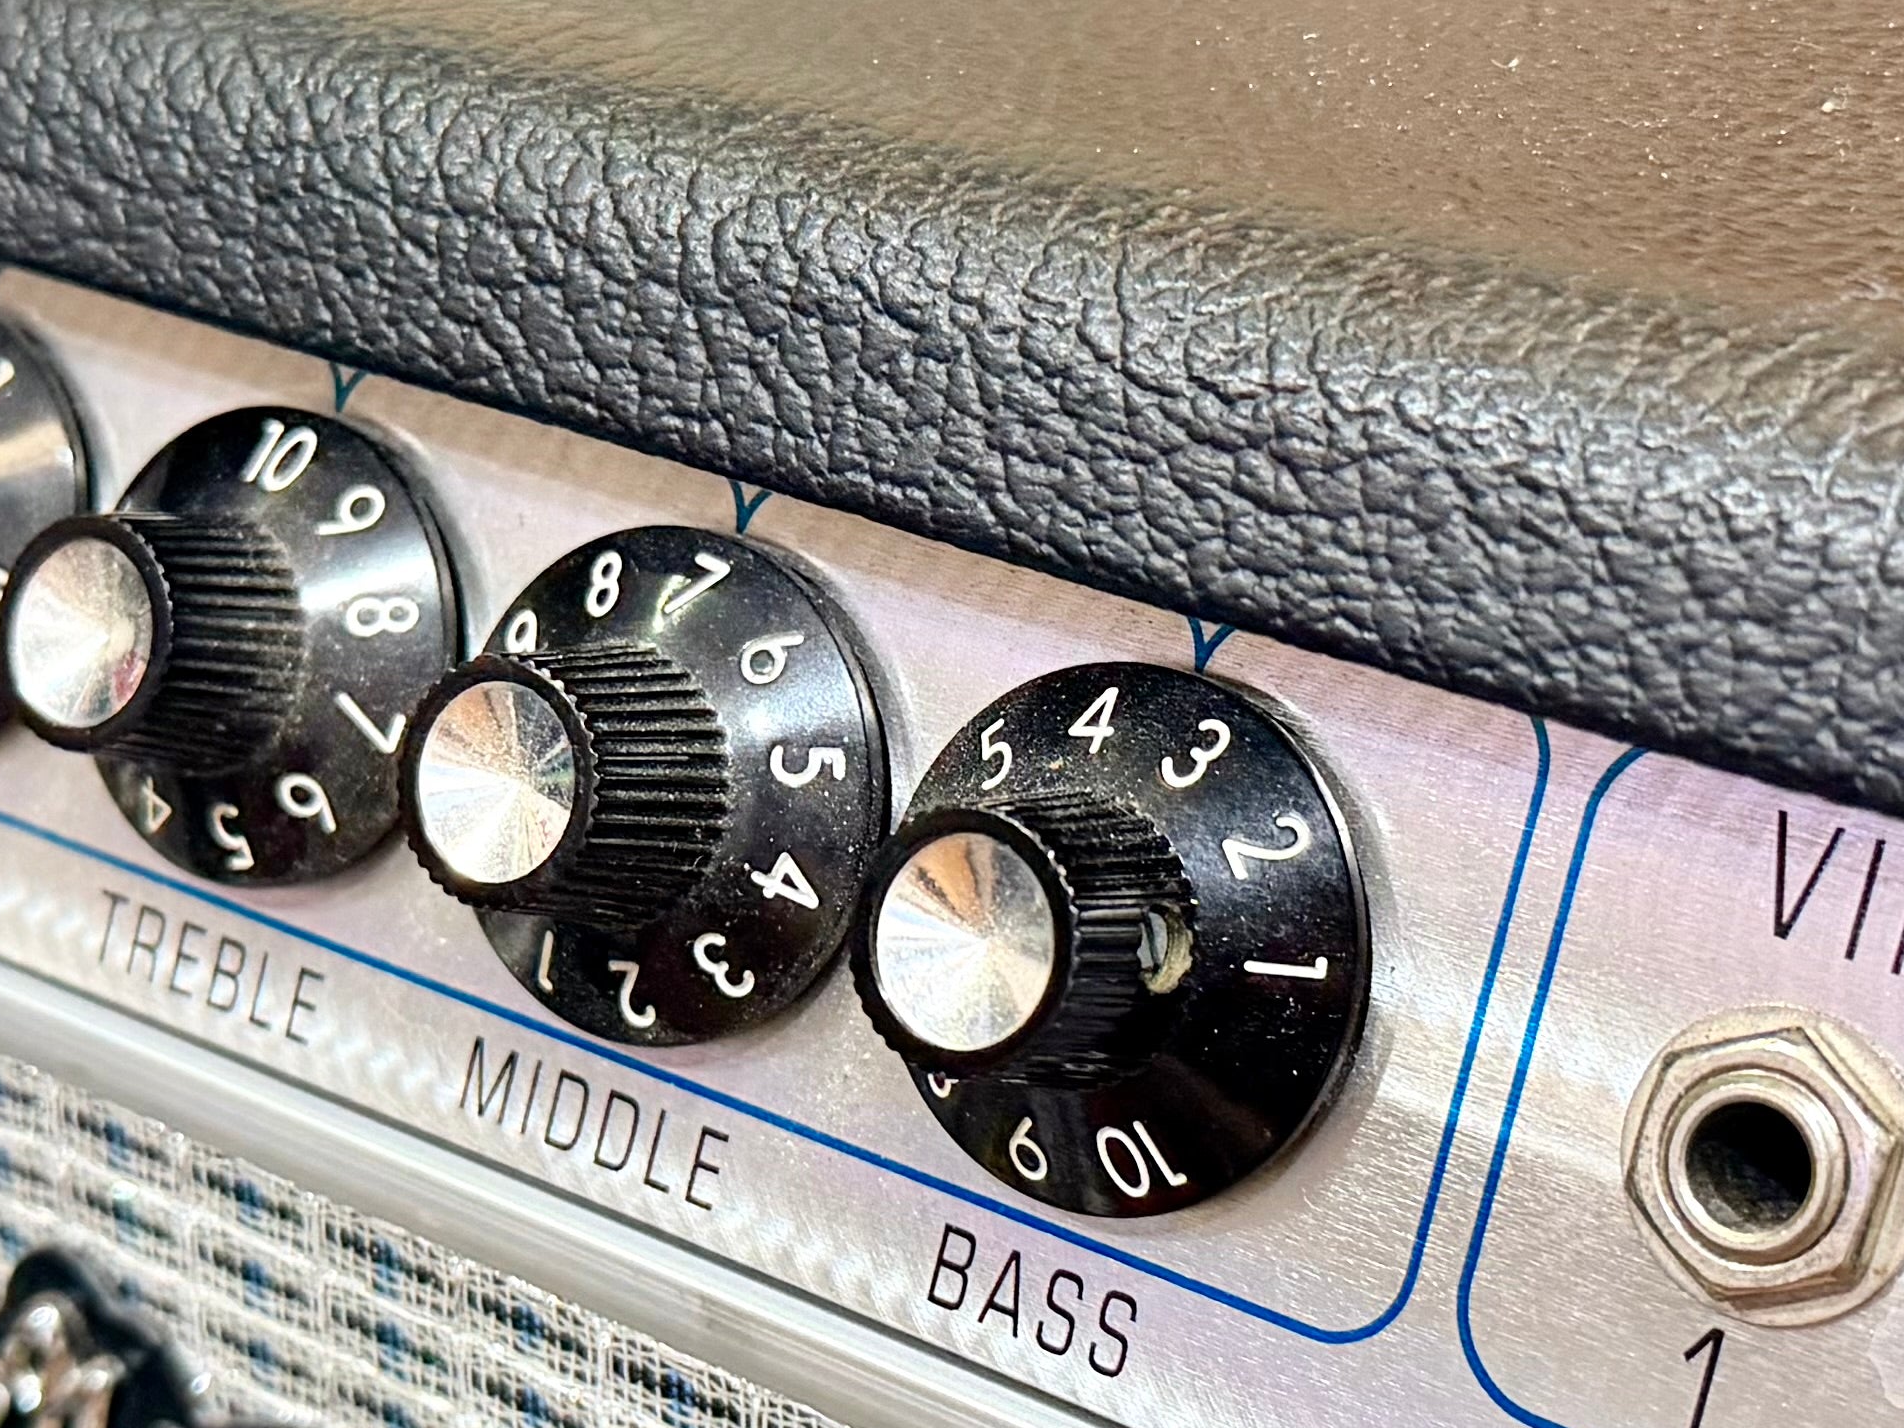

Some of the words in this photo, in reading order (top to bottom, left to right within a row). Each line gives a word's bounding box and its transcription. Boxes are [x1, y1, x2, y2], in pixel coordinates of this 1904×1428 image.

[242, 419, 317, 492] 10
[318, 484, 386, 536] 9
[346, 596, 420, 638] 8
[586, 550, 622, 618] 8
[663, 552, 731, 615] 7
[740, 631, 804, 685] 6
[335, 691, 406, 754] 7
[1067, 686, 1119, 754] 4
[1161, 718, 1231, 789] 3
[770, 744, 846, 788] 5
[980, 719, 1012, 791] 5
[208, 803, 255, 871] 5
[1221, 814, 1310, 880] 2
[750, 852, 819, 910] 4
[94, 888, 325, 1045] TREBLE
[608, 960, 656, 1029] 2
[693, 932, 755, 998] 3
[1243, 956, 1328, 979] 1
[460, 1036, 729, 1211] MIDDLE
[1096, 1120, 1187, 1197] 10
[927, 1223, 1137, 1378] BASS
